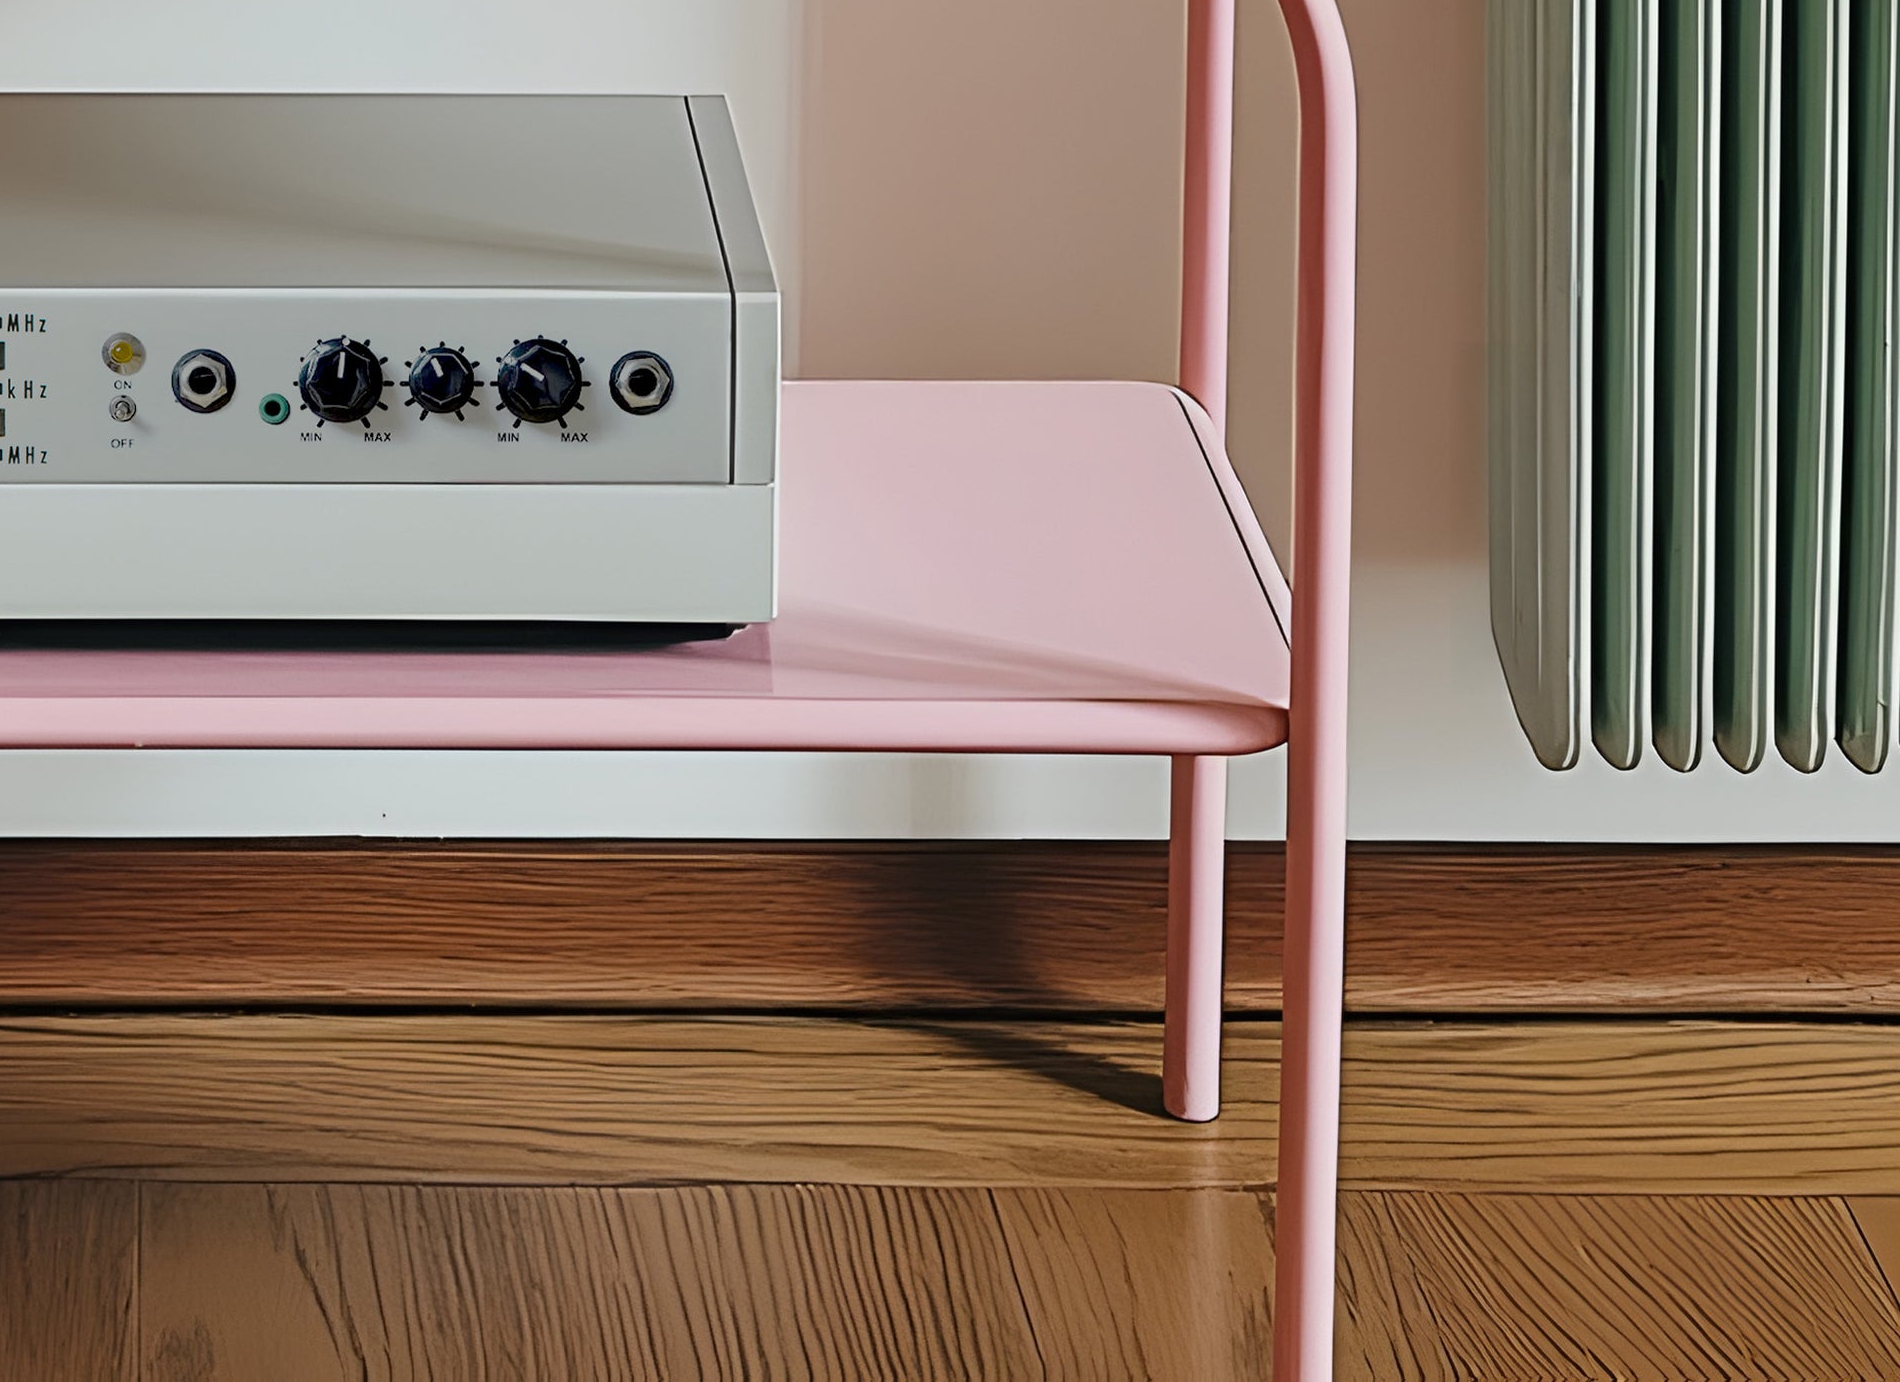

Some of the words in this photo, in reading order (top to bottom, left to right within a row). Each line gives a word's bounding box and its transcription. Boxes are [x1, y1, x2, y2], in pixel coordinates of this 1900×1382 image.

[7, 313, 47, 333] MHz
[113, 380, 133, 390] ON
[300, 432, 323, 443] MIN
[364, 432, 392, 443] MAX
[497, 432, 520, 443] MIN
[560, 432, 589, 443] MAX
[110, 438, 135, 449] OFF
[8, 446, 48, 464] MHz
